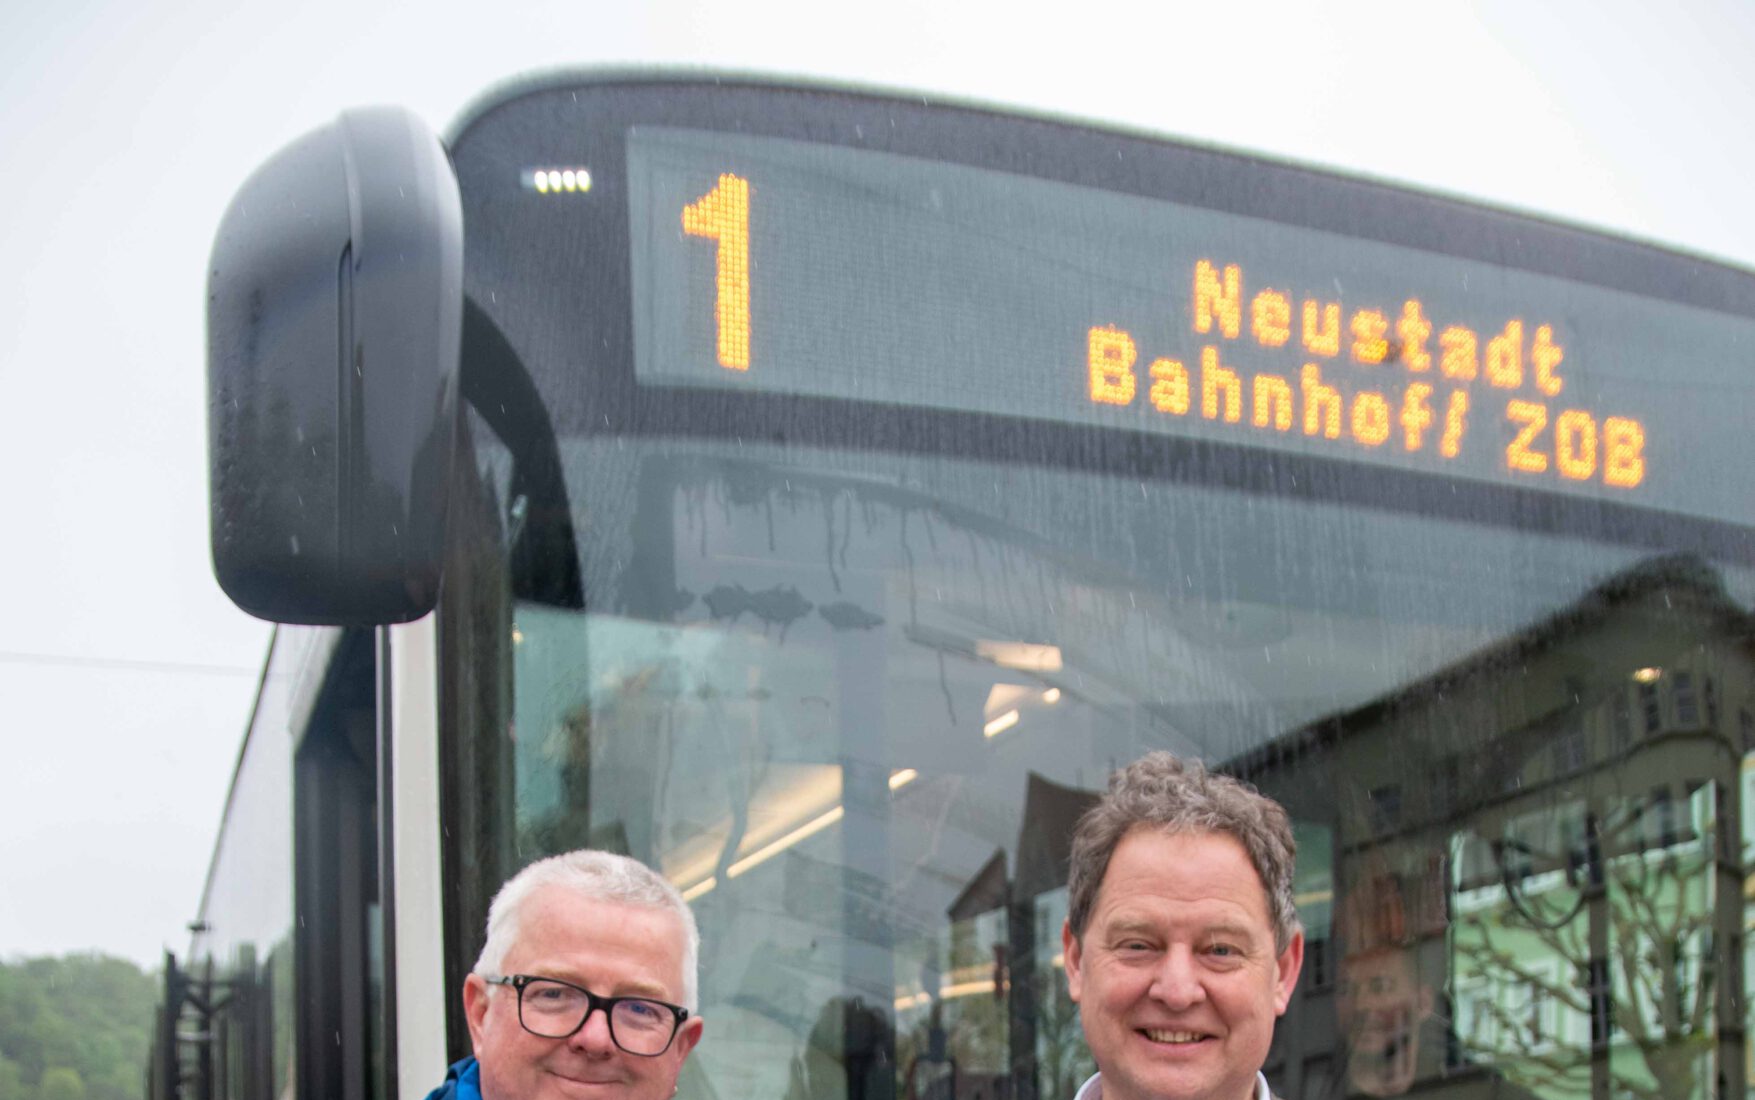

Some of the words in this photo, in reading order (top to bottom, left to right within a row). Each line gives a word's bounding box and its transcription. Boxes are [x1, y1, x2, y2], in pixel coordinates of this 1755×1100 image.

[683, 173, 750, 372] 1
[1194, 260, 1563, 397] Neustadt
[1088, 324, 1468, 459] Bahnhof/
[1505, 399, 1646, 489] ZOB
